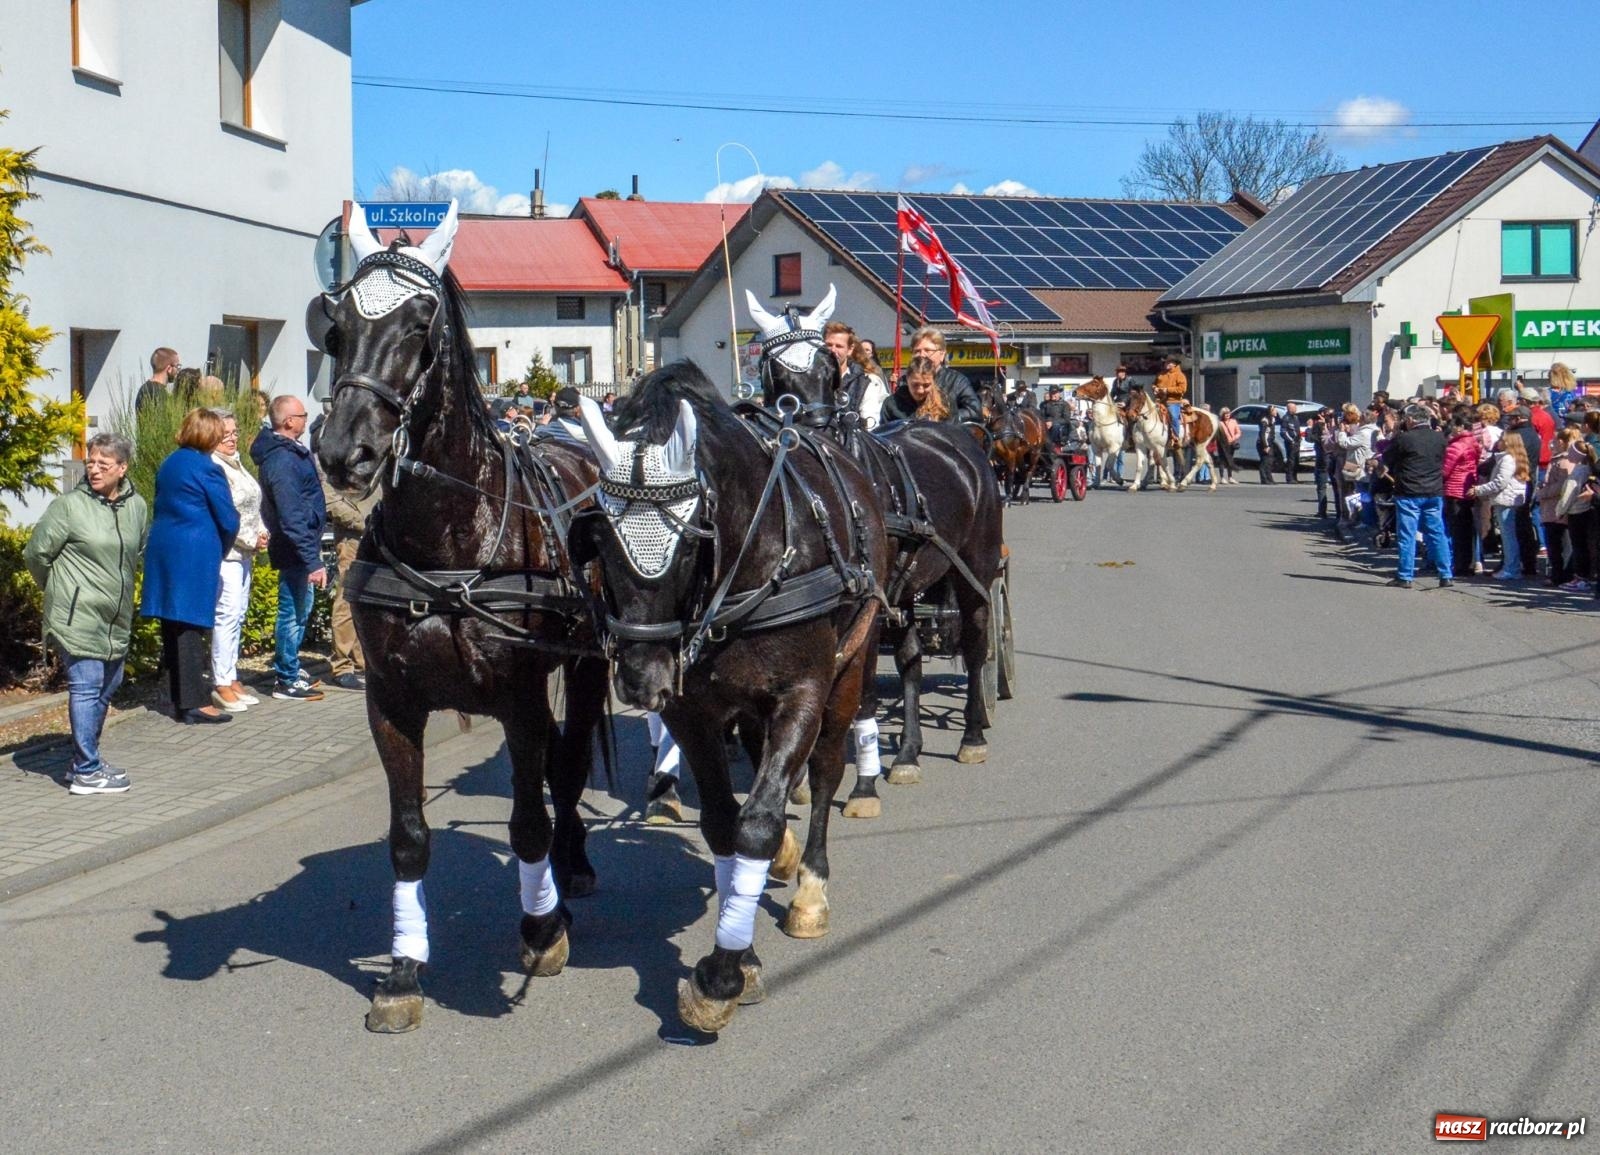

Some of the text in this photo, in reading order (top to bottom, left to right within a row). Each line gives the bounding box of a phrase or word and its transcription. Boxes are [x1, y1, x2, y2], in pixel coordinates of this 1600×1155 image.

[1224, 338, 1341, 353] APTEKA ZIELONA
[966, 350, 1012, 360] LEWIAAN
